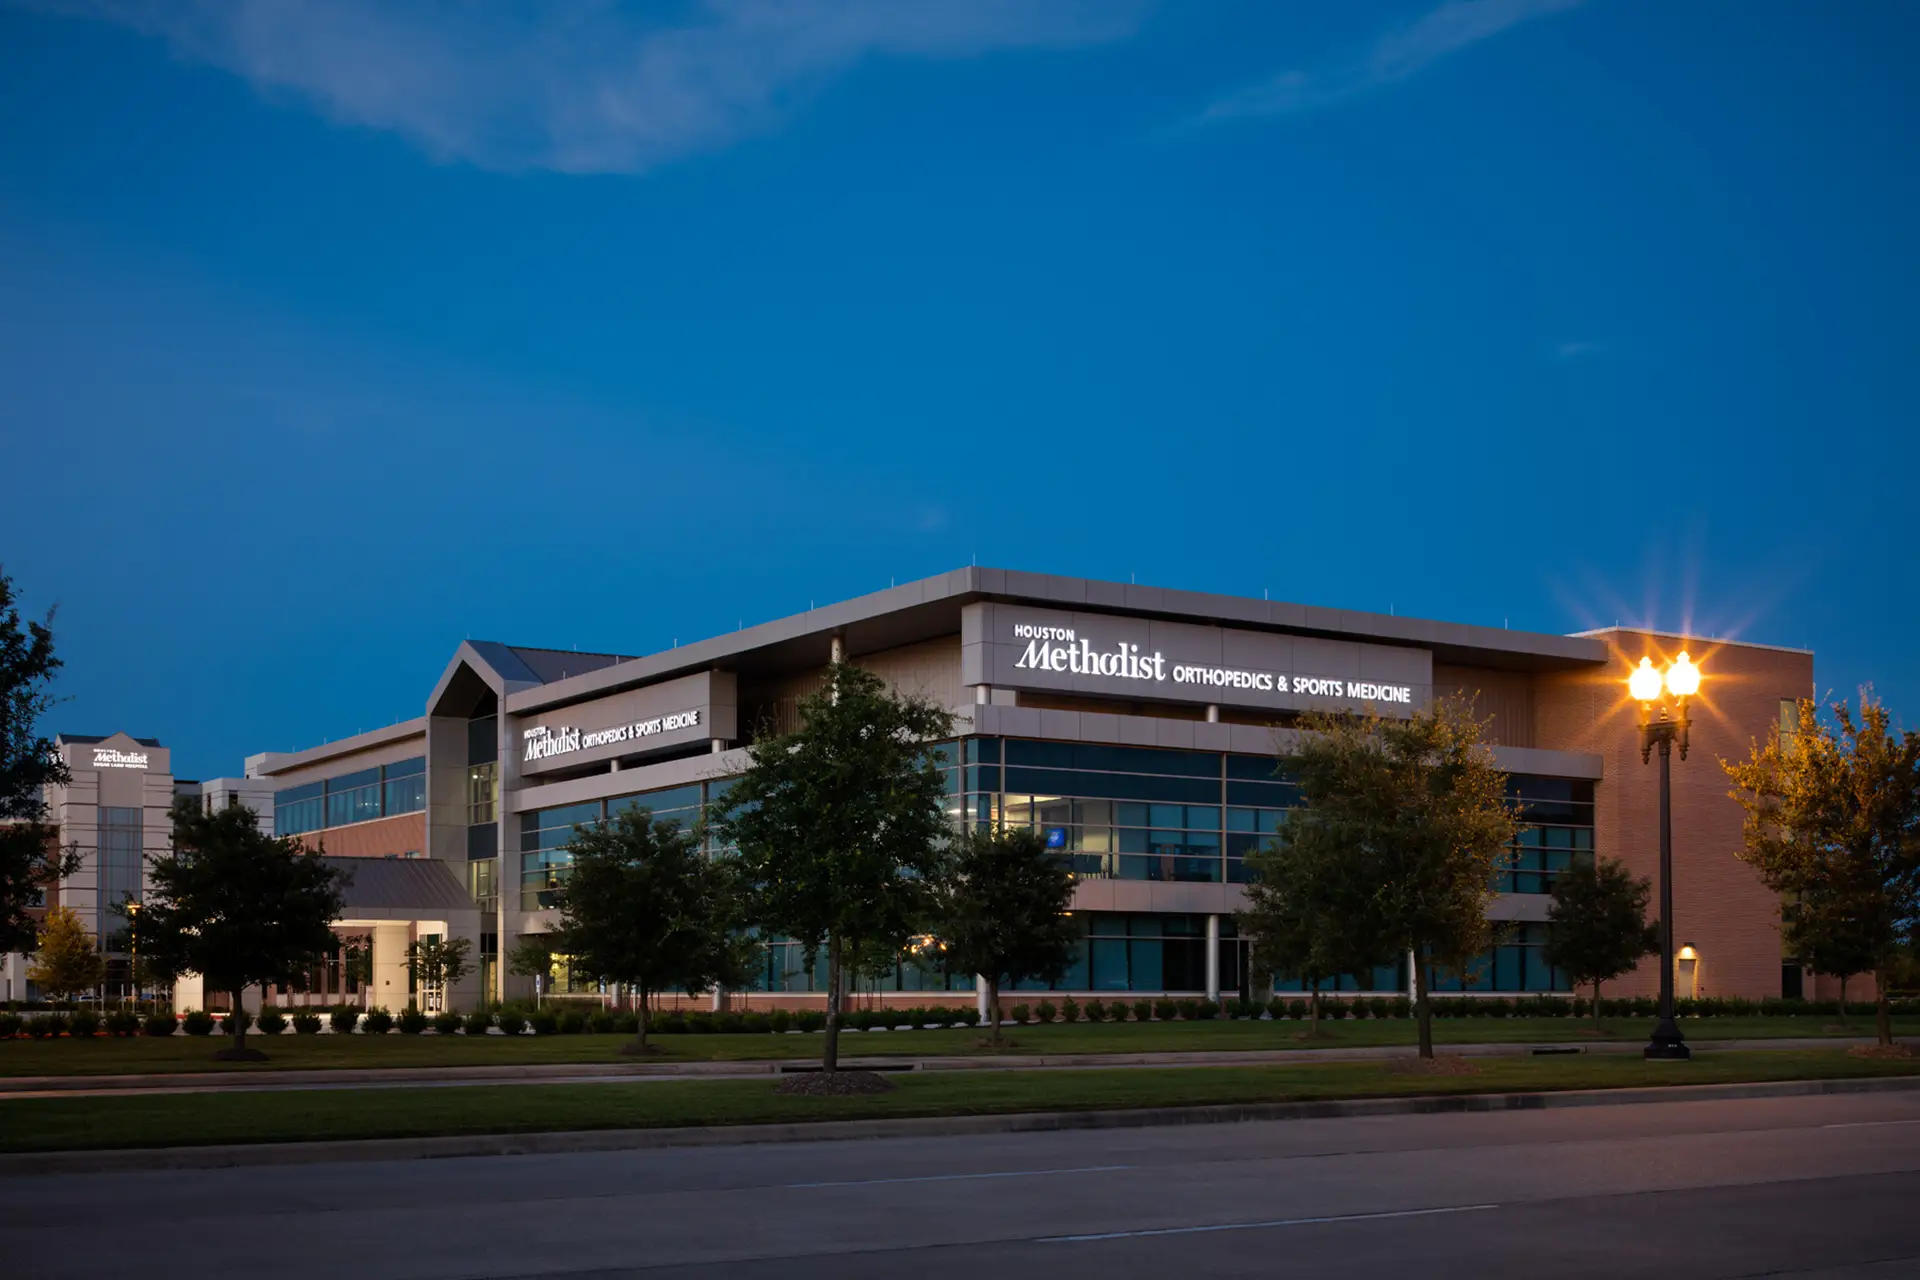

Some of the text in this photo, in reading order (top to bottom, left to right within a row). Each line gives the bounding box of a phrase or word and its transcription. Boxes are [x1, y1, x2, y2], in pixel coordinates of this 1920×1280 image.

[1014, 624, 1075, 642] HOUSTON
[1014, 638, 1166, 682] Methodist
[1172, 665, 1411, 703] ORTHOPEDICS & SPORTS MEDICINE
[524, 727, 581, 761] Methodist
[582, 710, 698, 749] ORTHOPEDICS & SPORTS MEDICINE
[94, 751, 148, 764] Methodist
